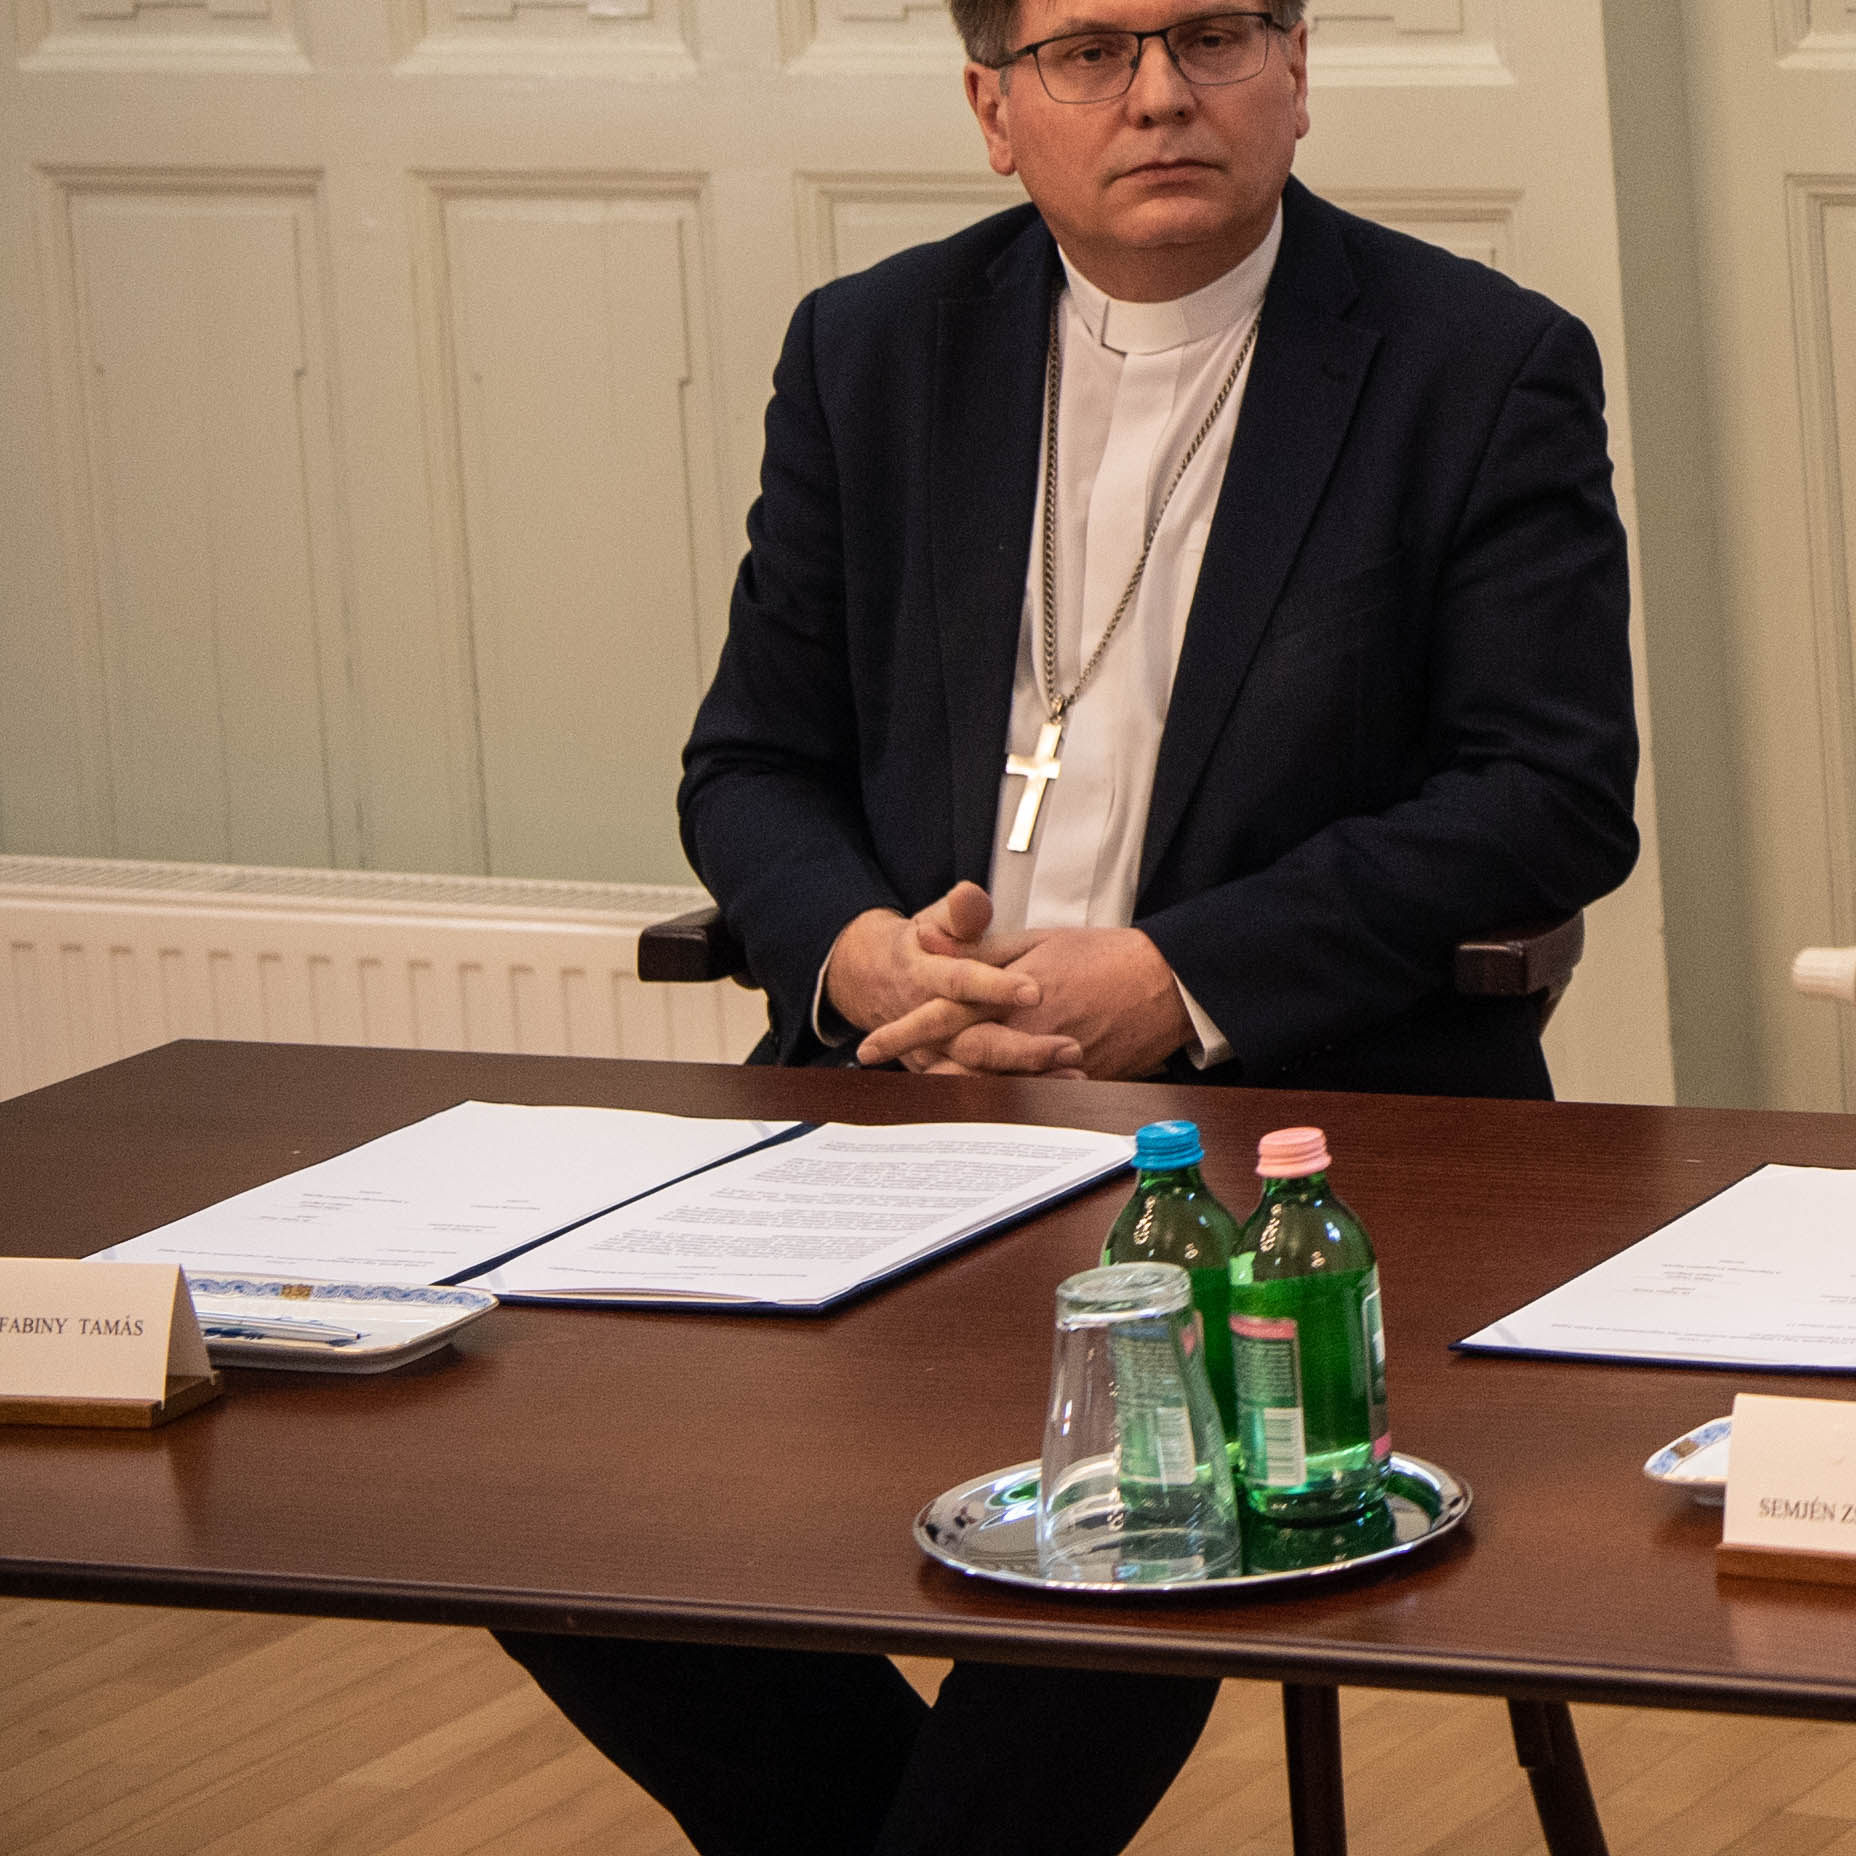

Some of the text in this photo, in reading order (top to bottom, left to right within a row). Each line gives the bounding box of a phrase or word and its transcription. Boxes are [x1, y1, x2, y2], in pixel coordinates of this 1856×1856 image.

[0, 1315, 145, 1336] FABINY TAMÁS
[1759, 1496, 1836, 1521] SEMJÉN
